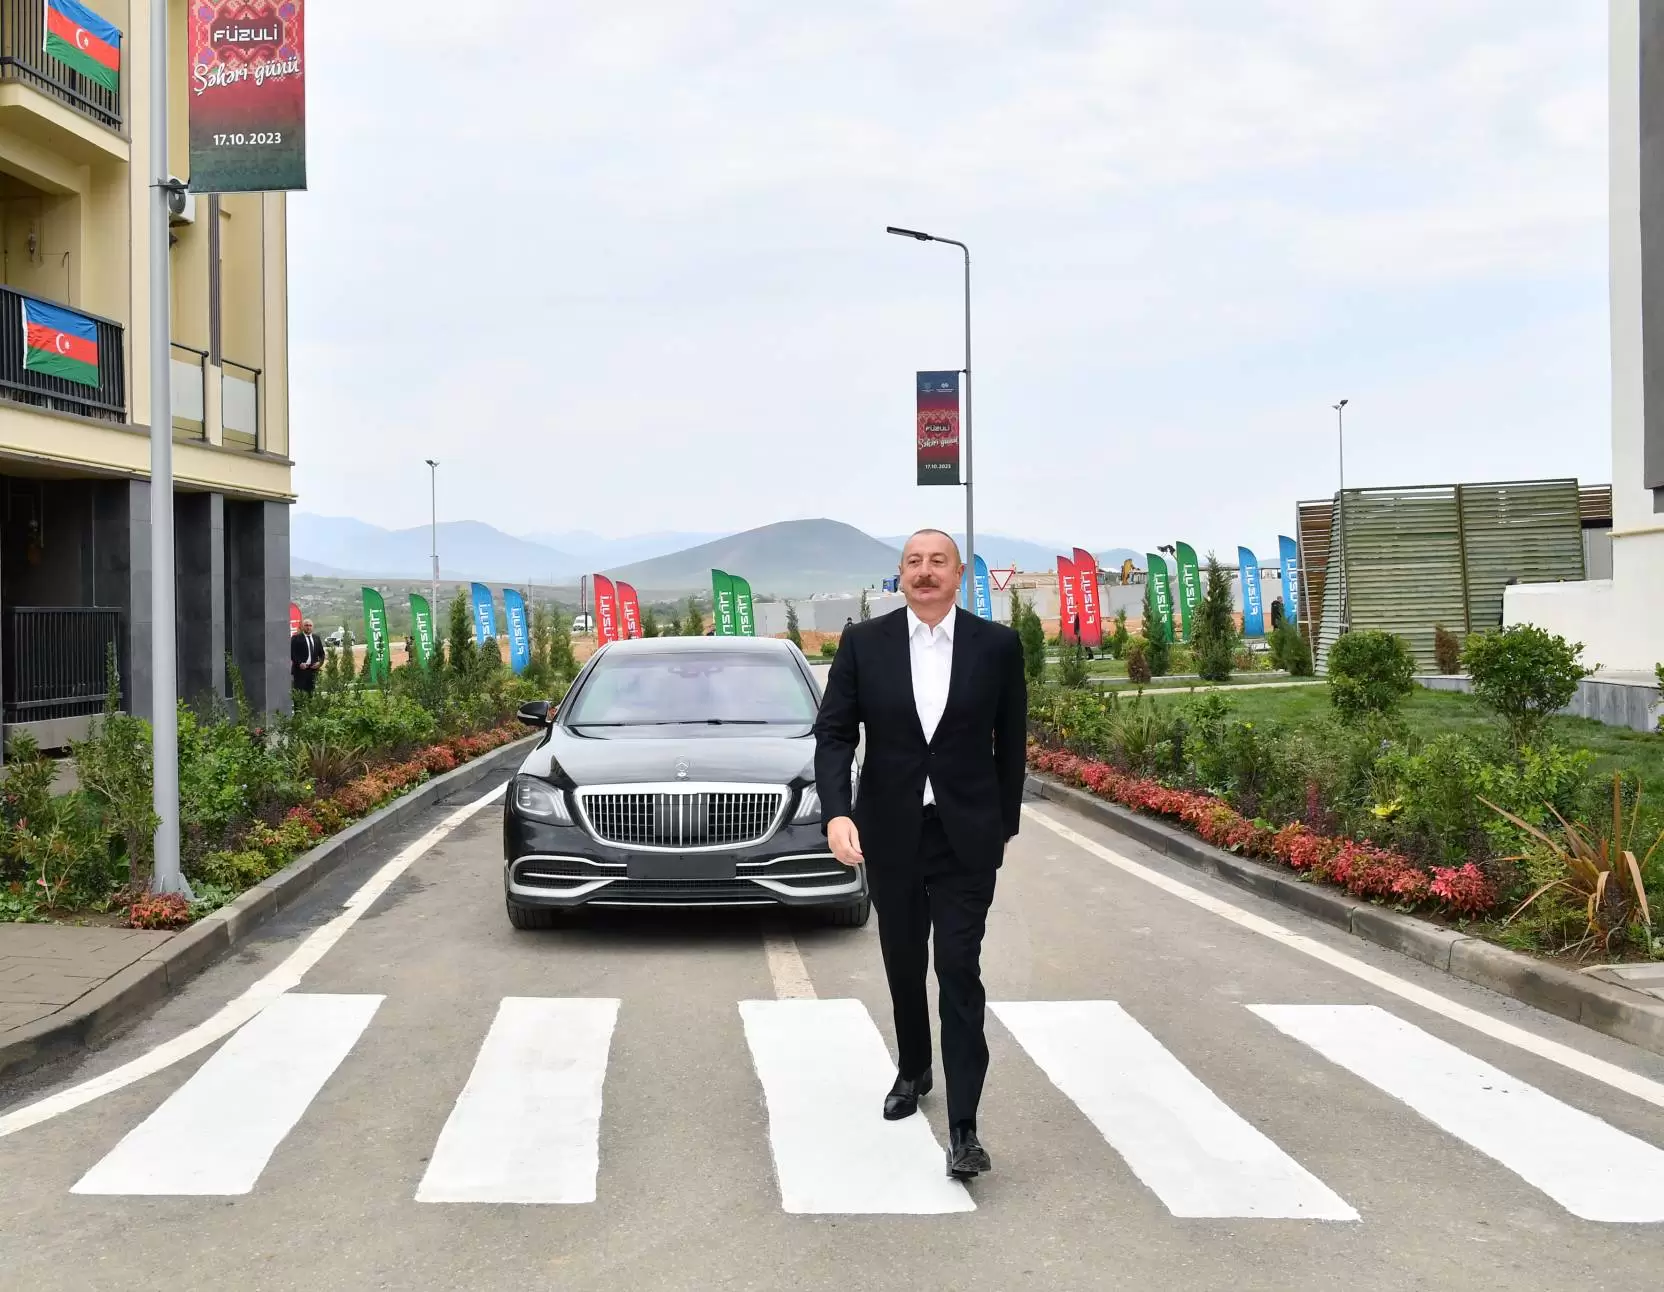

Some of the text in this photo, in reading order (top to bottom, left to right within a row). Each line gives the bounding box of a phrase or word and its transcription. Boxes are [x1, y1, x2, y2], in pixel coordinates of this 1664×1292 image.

[213, 24, 278, 42] FÜZULİ
[193, 56, 300, 96] Şəhəri günü
[213, 132, 282, 146] 17.10.2023
